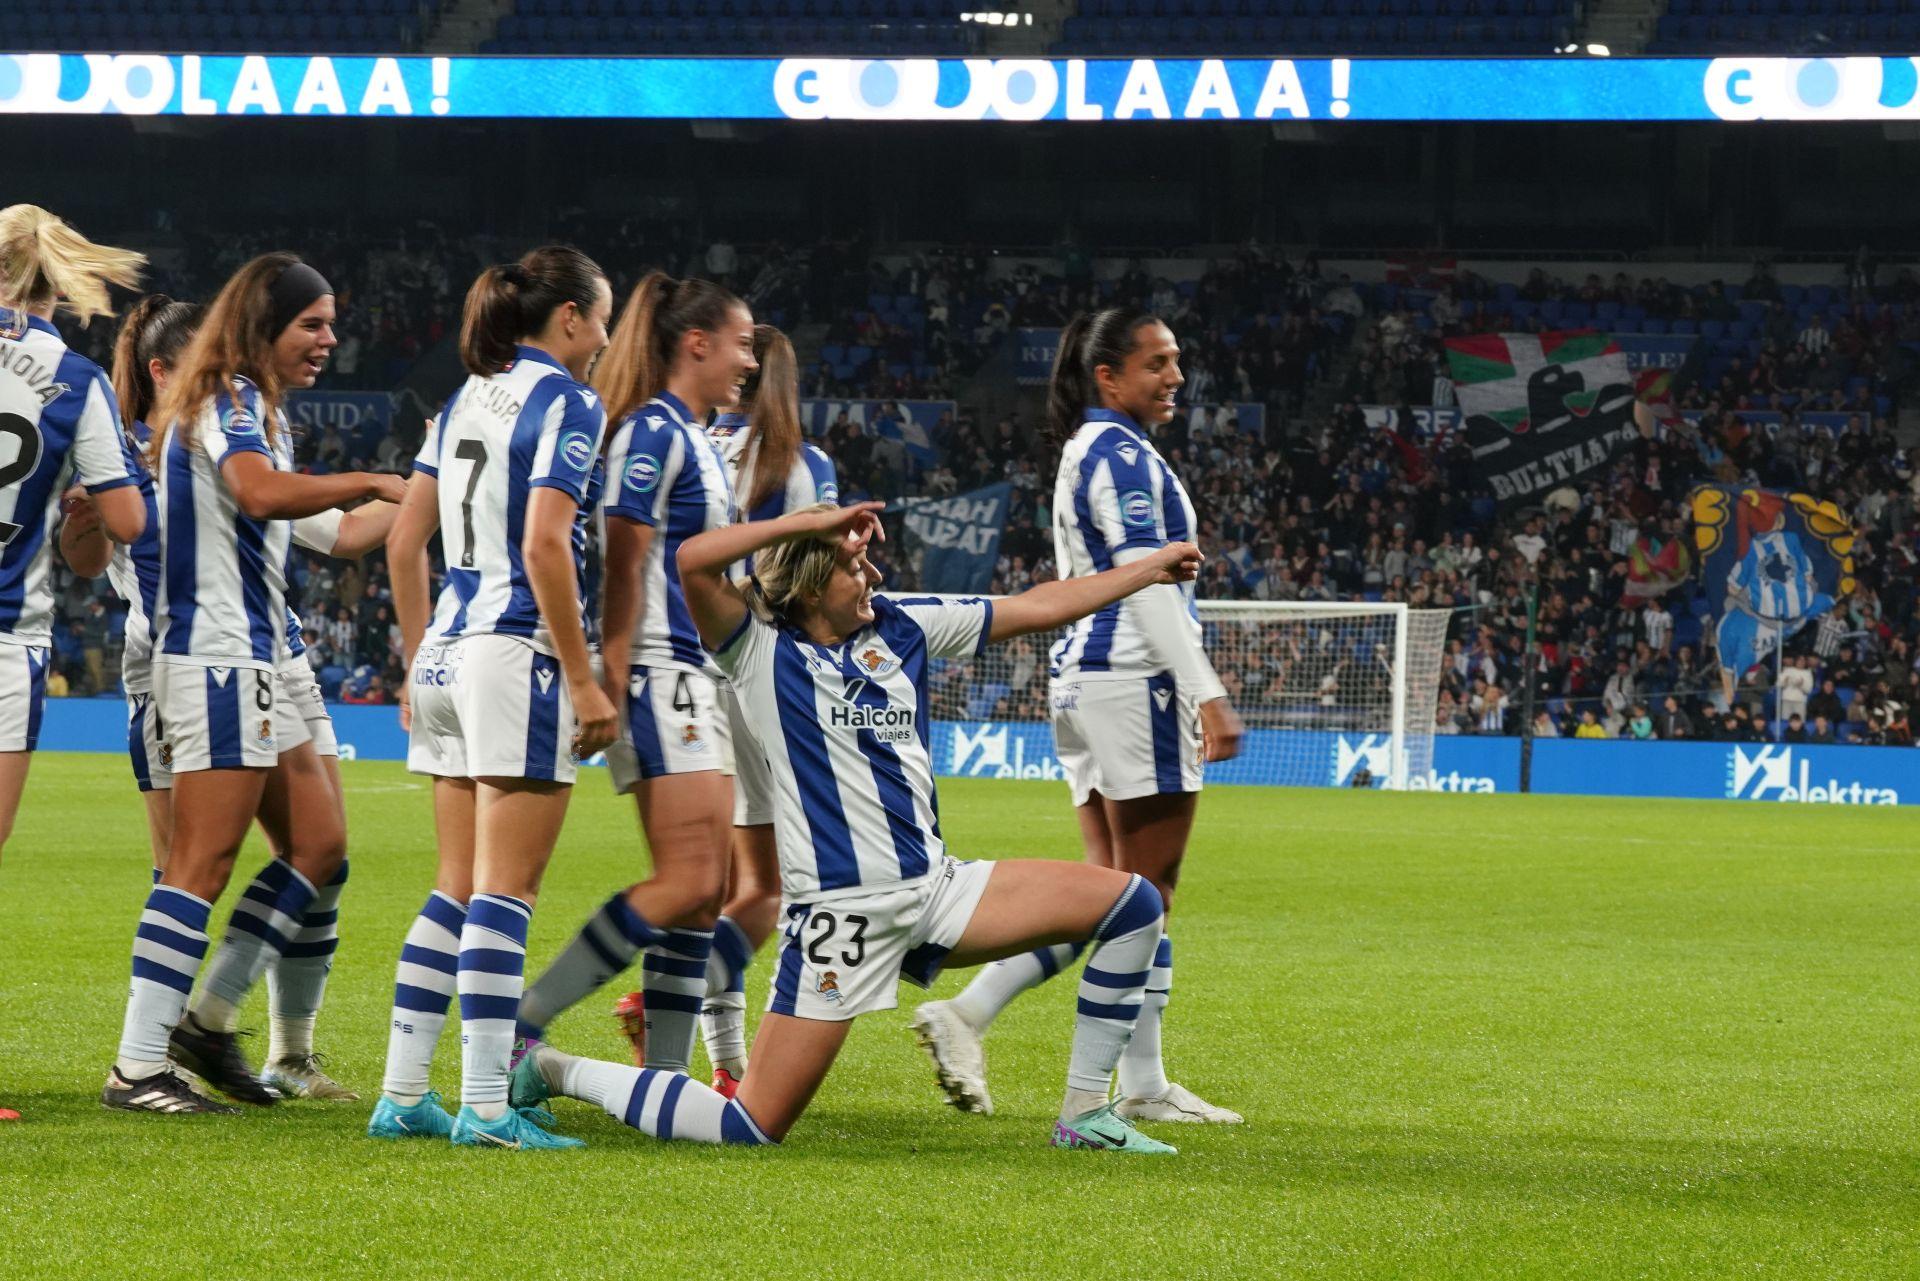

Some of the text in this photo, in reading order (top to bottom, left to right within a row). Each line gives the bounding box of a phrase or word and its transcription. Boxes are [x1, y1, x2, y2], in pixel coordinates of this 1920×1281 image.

[454, 438, 488, 567] 7
[255, 669, 272, 712] 8
[673, 671, 697, 719] 4
[831, 705, 912, 726] Halcón
[877, 729, 910, 742] viajes
[1778, 758, 1899, 806] elektra
[808, 911, 869, 968] 23
[394, 1020, 413, 1034] RS
